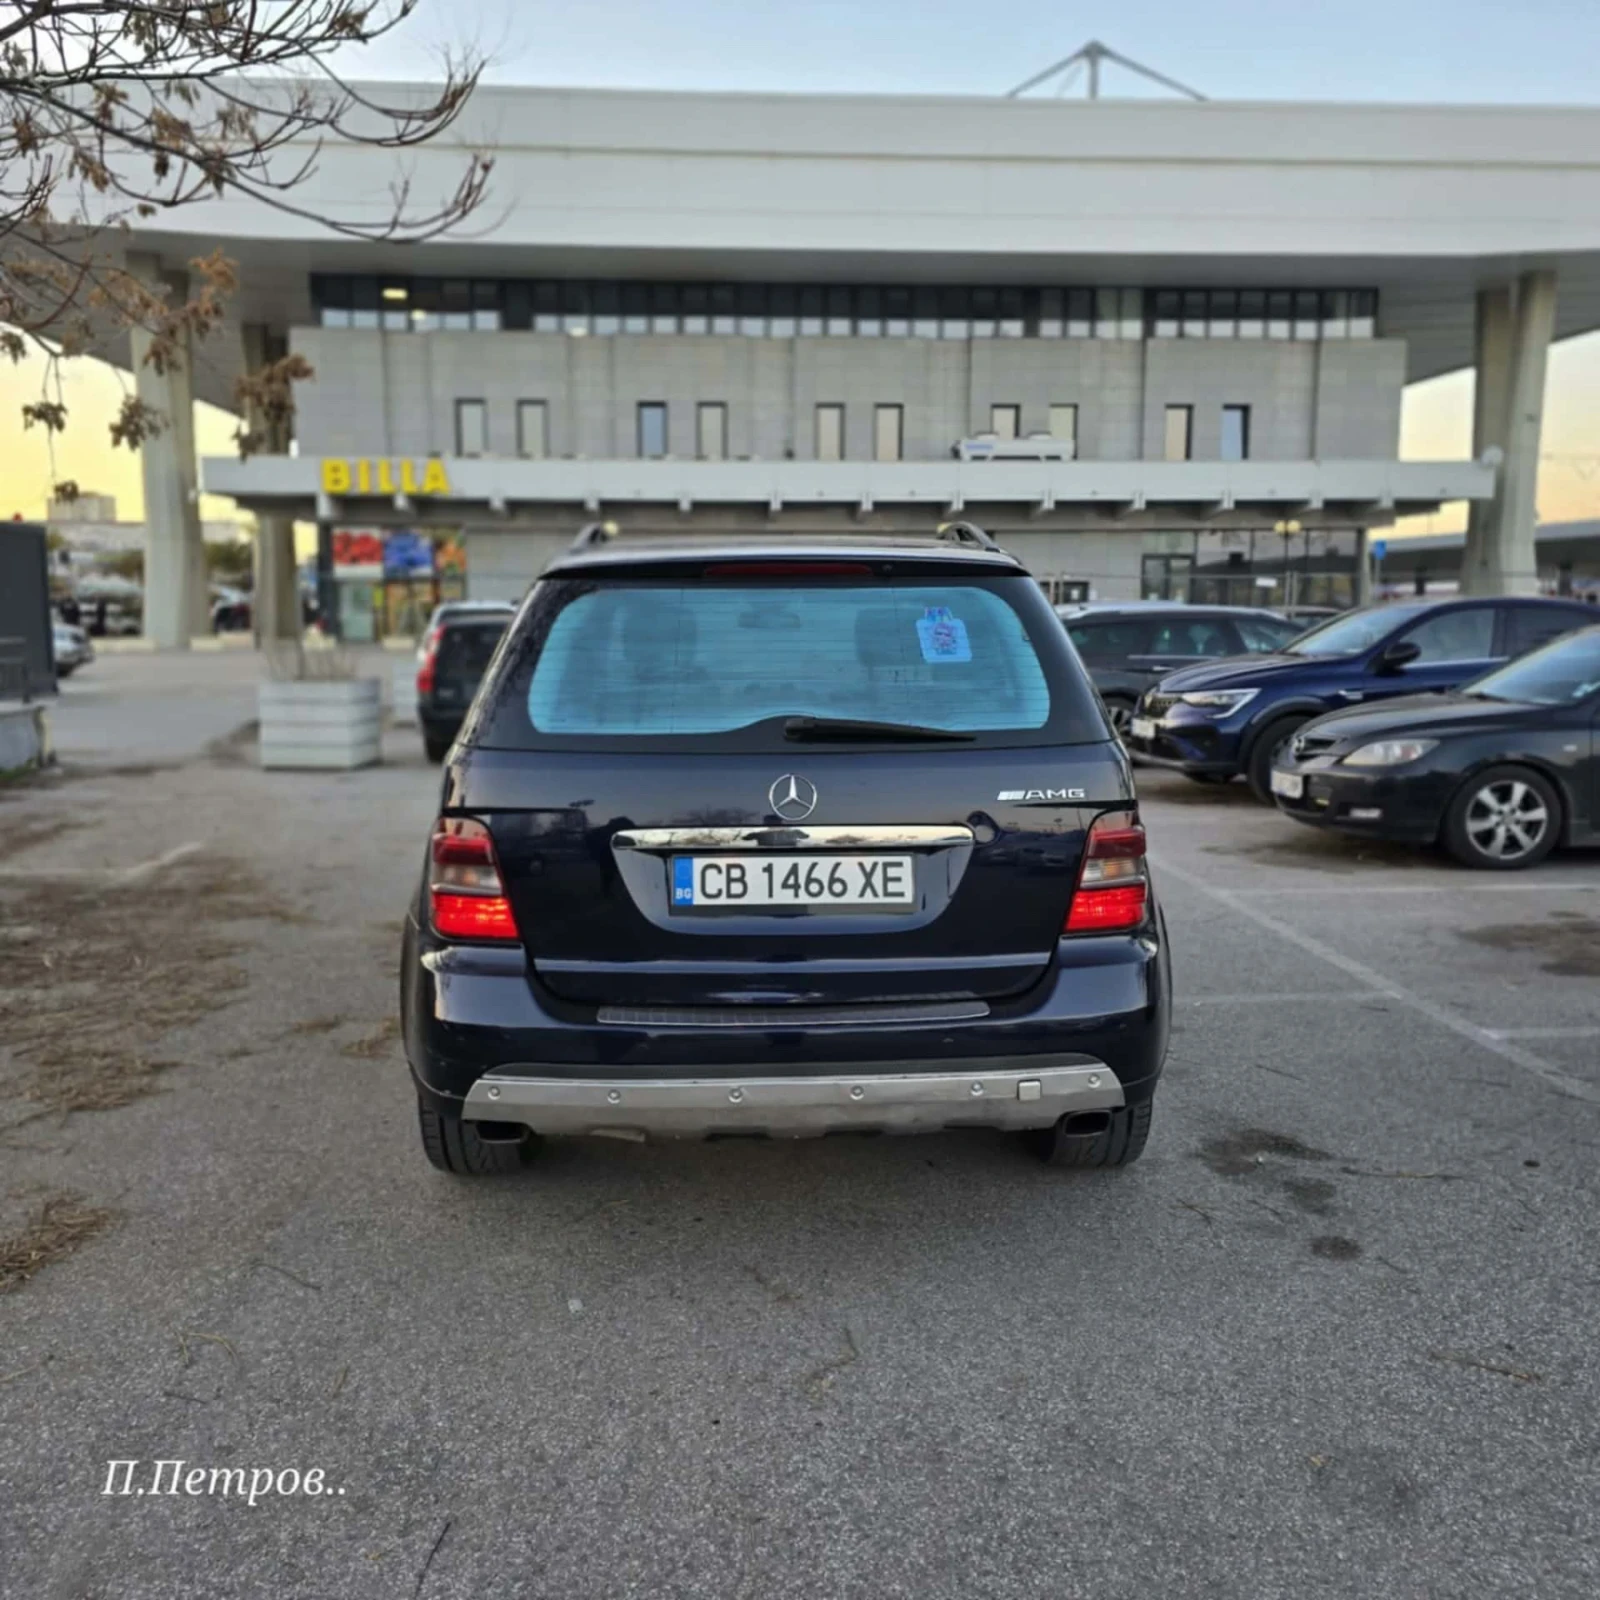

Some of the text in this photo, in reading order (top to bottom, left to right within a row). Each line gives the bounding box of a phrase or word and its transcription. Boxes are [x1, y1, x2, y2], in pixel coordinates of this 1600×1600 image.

[321, 458, 449, 494] BILLA
[1025, 788, 1085, 800] AMG
[700, 861, 905, 899] CB 1466 XE
[675, 888, 692, 899] BG
